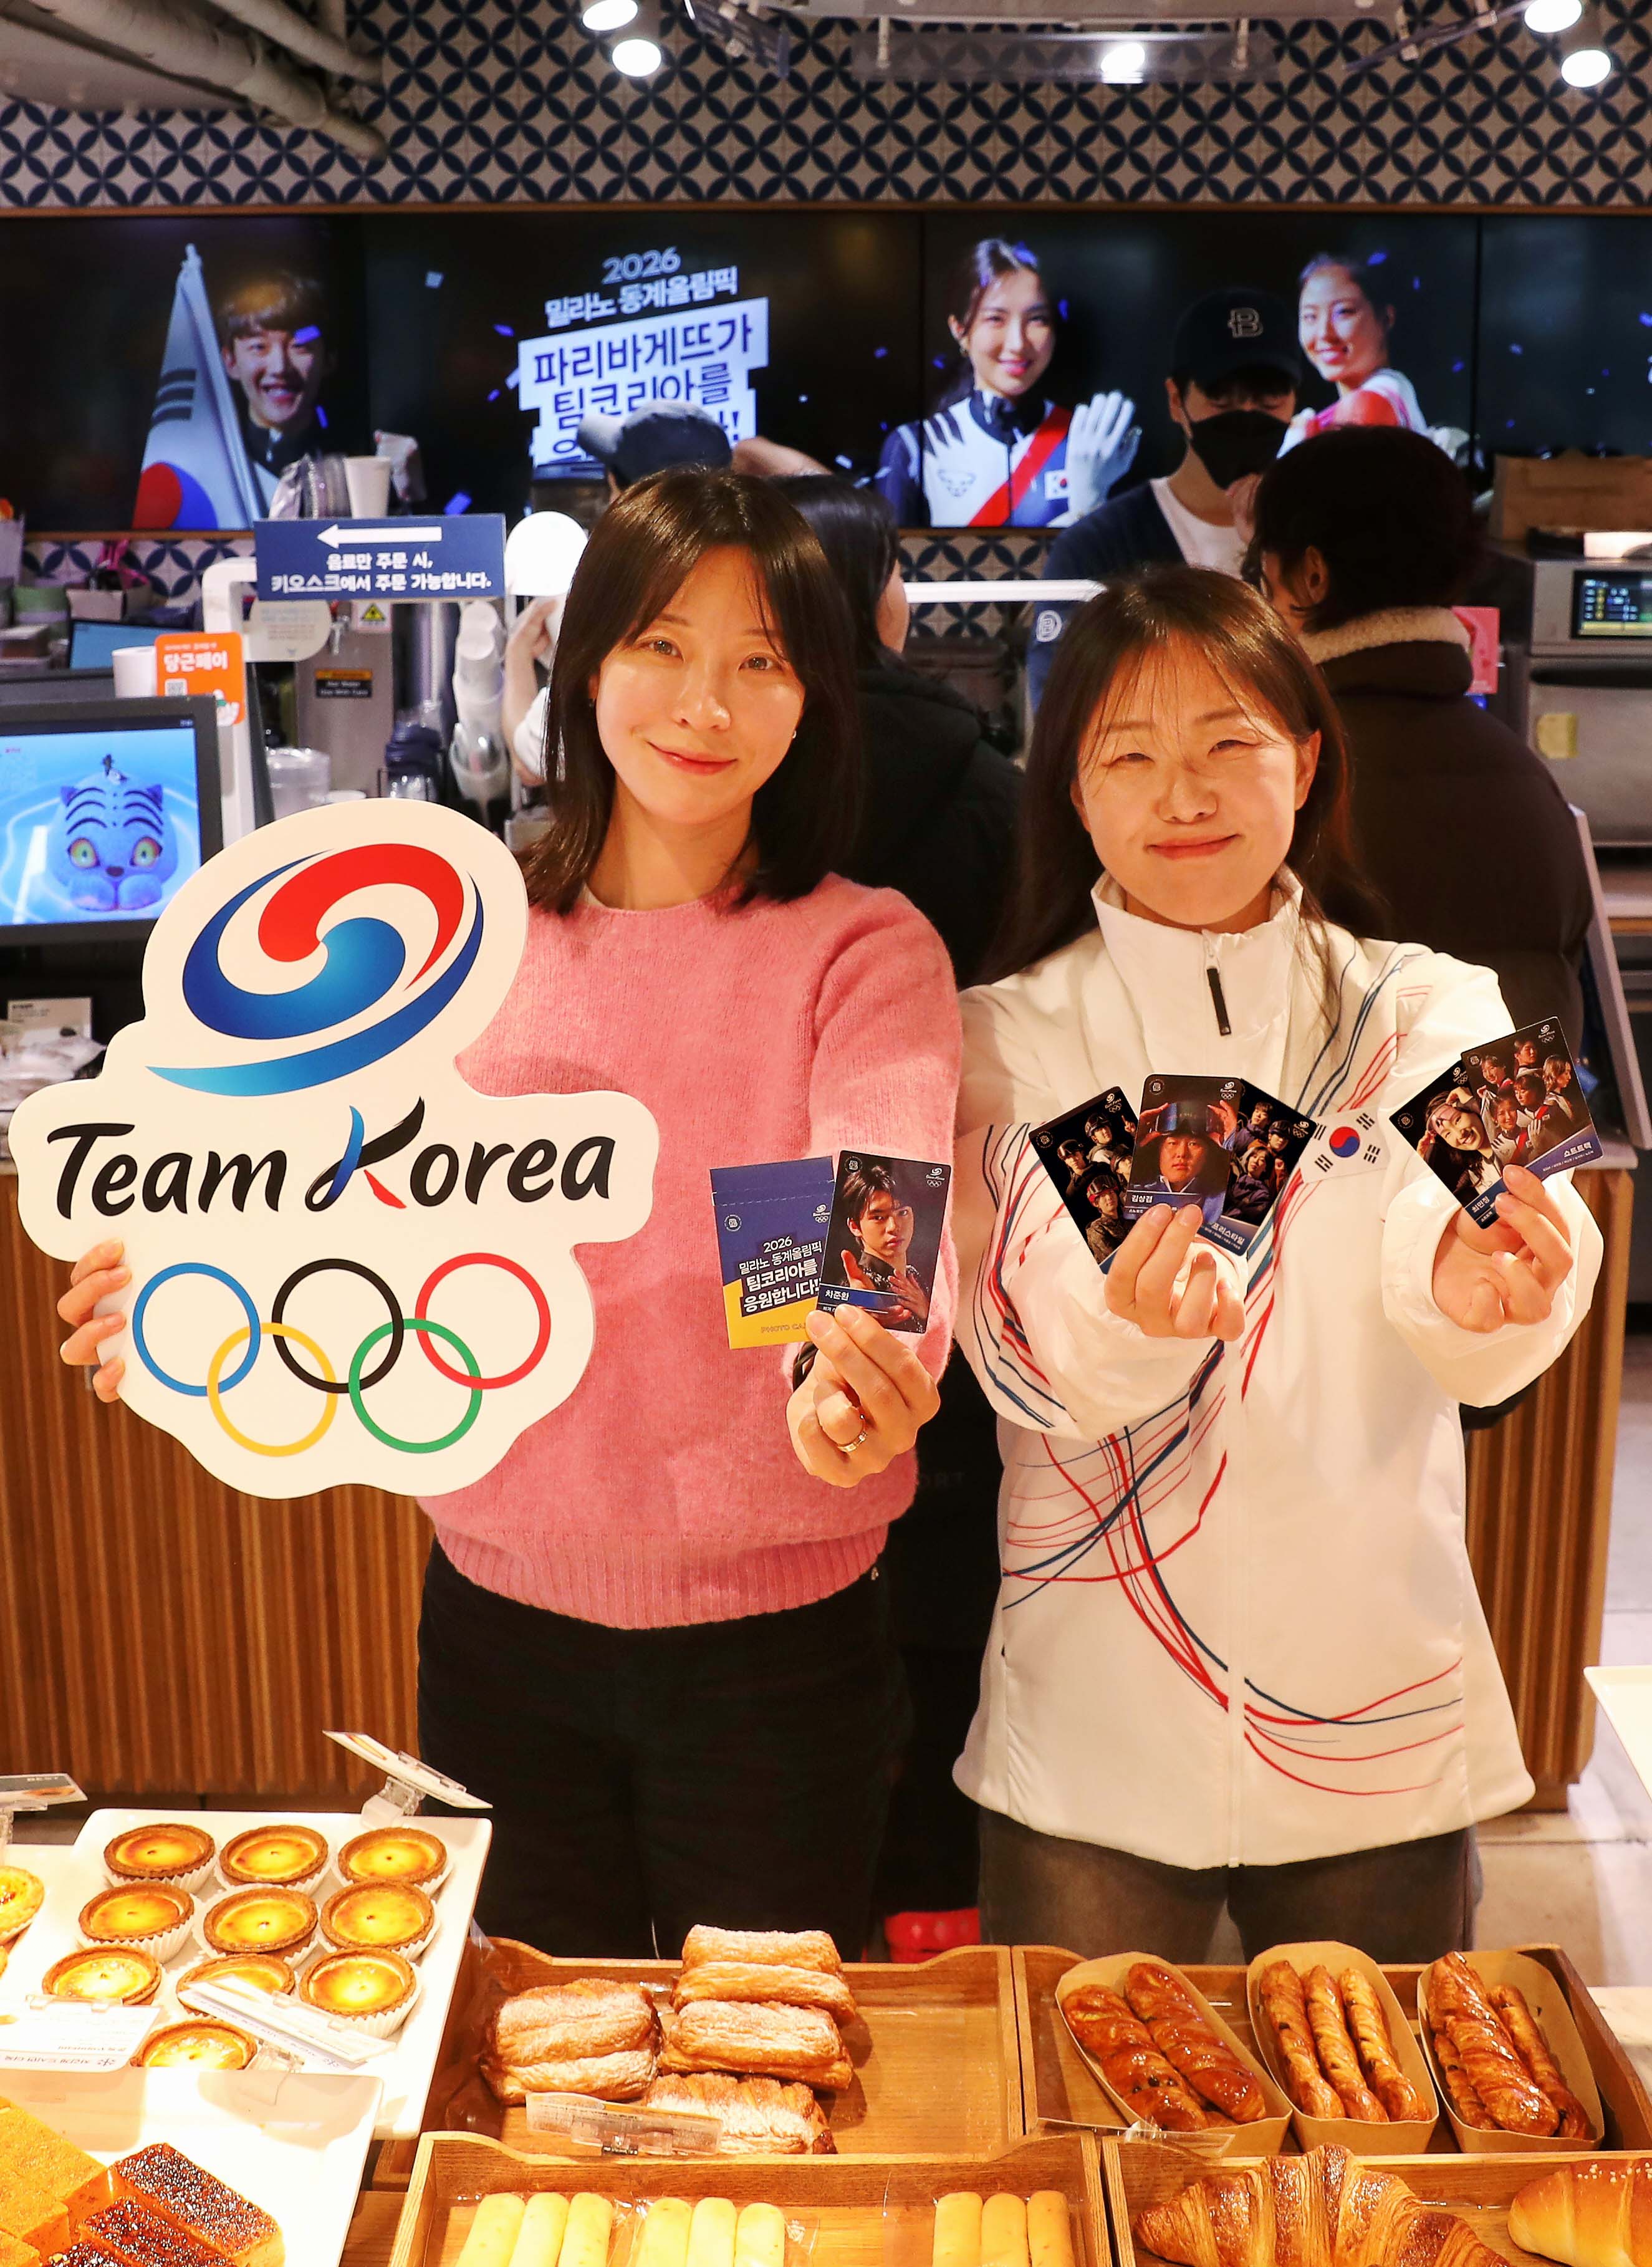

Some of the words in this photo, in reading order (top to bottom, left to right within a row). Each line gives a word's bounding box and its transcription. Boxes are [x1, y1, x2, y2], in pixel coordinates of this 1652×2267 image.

[602, 246, 681, 285] 2026
[544, 292, 617, 329] 밀라노
[618, 266, 738, 314] 동계올림픽
[534, 314, 754, 387] 파리바게뜨가
[326, 552, 373, 572] 음료만
[375, 551, 408, 570] 주문
[411, 551, 434, 569] 시,
[271, 574, 371, 593] 키오스크에서
[375, 573, 408, 592] 주문
[410, 571, 492, 592] 가능합니다.
[163, 650, 229, 673] 당근페이
[47, 1122, 287, 1220] Team
[304, 1096, 617, 1211] Korea
[1472, 1196, 1490, 1213] 최민정
[739, 1258, 771, 1275] 밀라노
[771, 1241, 822, 1266] 동계올림픽
[762, 1236, 793, 1253] 2026
[746, 1258, 819, 1292] 팀코리아를
[825, 1289, 850, 1302] 차준환
